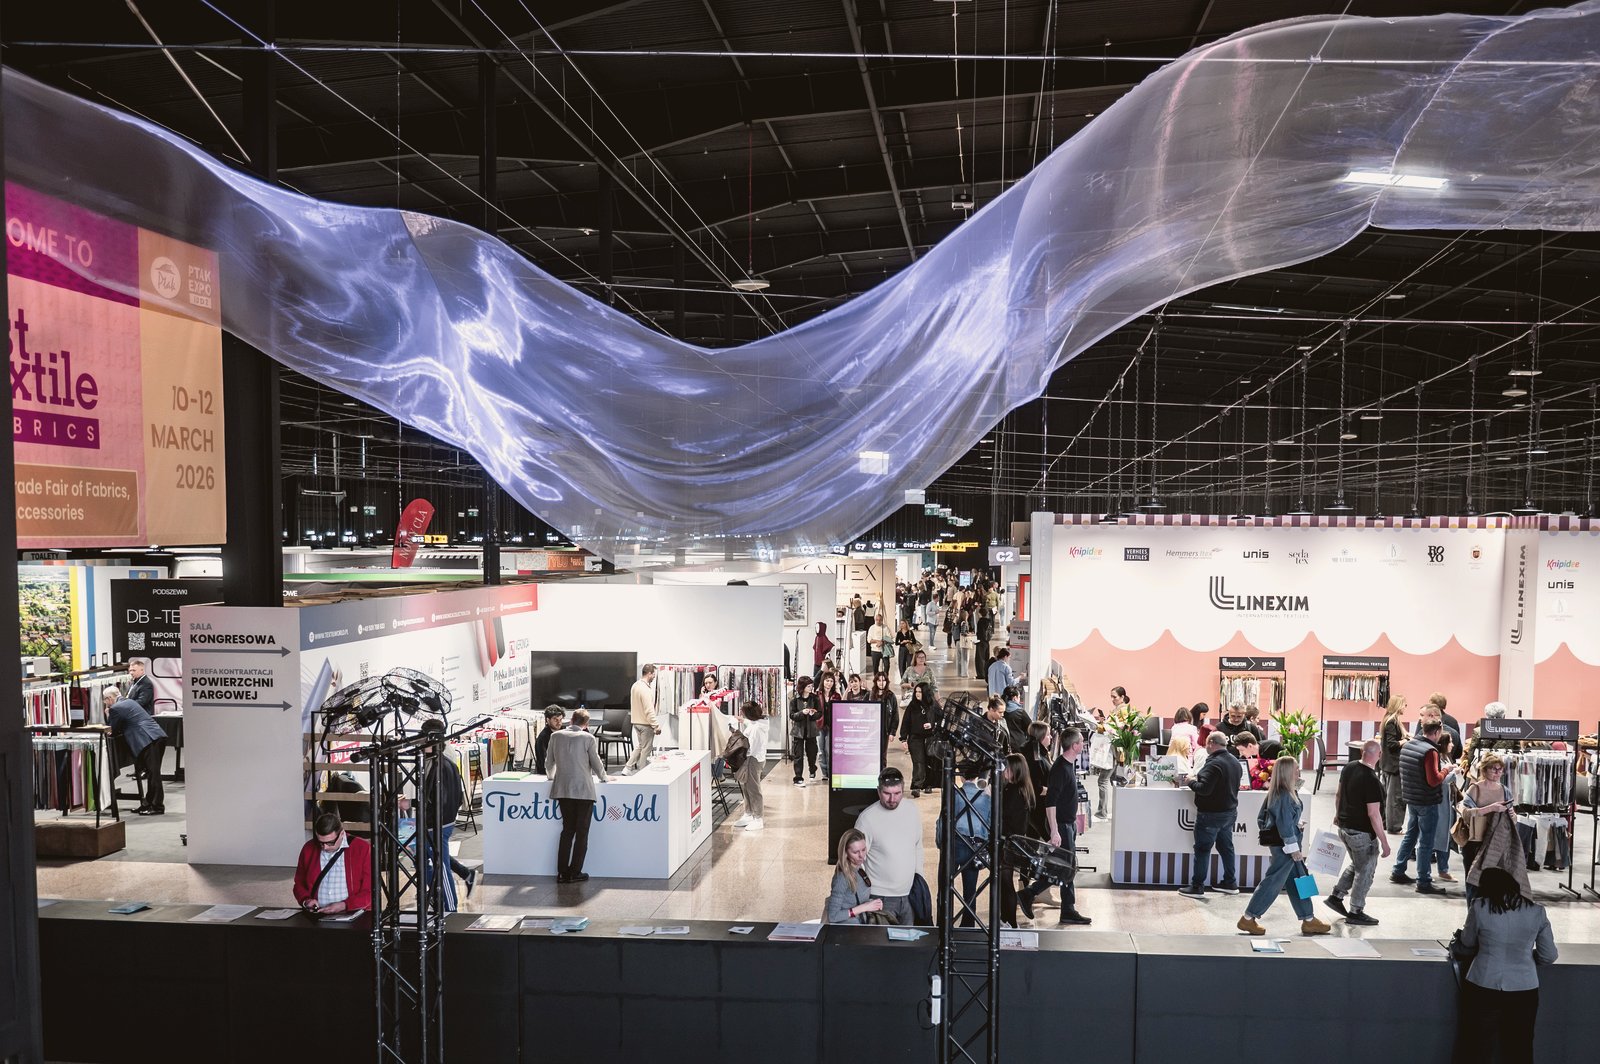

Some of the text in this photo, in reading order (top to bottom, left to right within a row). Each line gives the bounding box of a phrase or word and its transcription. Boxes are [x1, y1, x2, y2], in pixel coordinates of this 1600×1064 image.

[65, 234, 93, 268] TO
[188, 264, 212, 283] PTAK
[188, 279, 212, 298] EXPO
[172, 385, 213, 415] 10-12
[13, 416, 95, 442] BRICS
[151, 423, 214, 453] MARCH
[176, 464, 215, 490] 2026
[15, 478, 130, 501] ade Fair of Fabrics,
[801, 545, 816, 555] C3
[855, 542, 867, 551] C7
[31, 552, 60, 561] TOALETY
[995, 551, 1015, 563] C2
[1242, 548, 1270, 559] unis
[1288, 549, 1309, 558] seda
[1518, 545, 1526, 618] LINEXIM
[1547, 579, 1575, 589] unis
[152, 588, 188, 596] PODSZEWKI
[1236, 595, 1310, 611] LINEXIM
[126, 608, 150, 624] DB
[189, 622, 213, 631] SALA
[151, 640, 176, 648] TKANIN
[189, 633, 277, 645] KONGRESOWA
[191, 668, 274, 676] STREFA KONTRAKTACJI
[191, 677, 274, 688] POWIERZCHNI
[191, 689, 258, 700] TARGOWEJ
